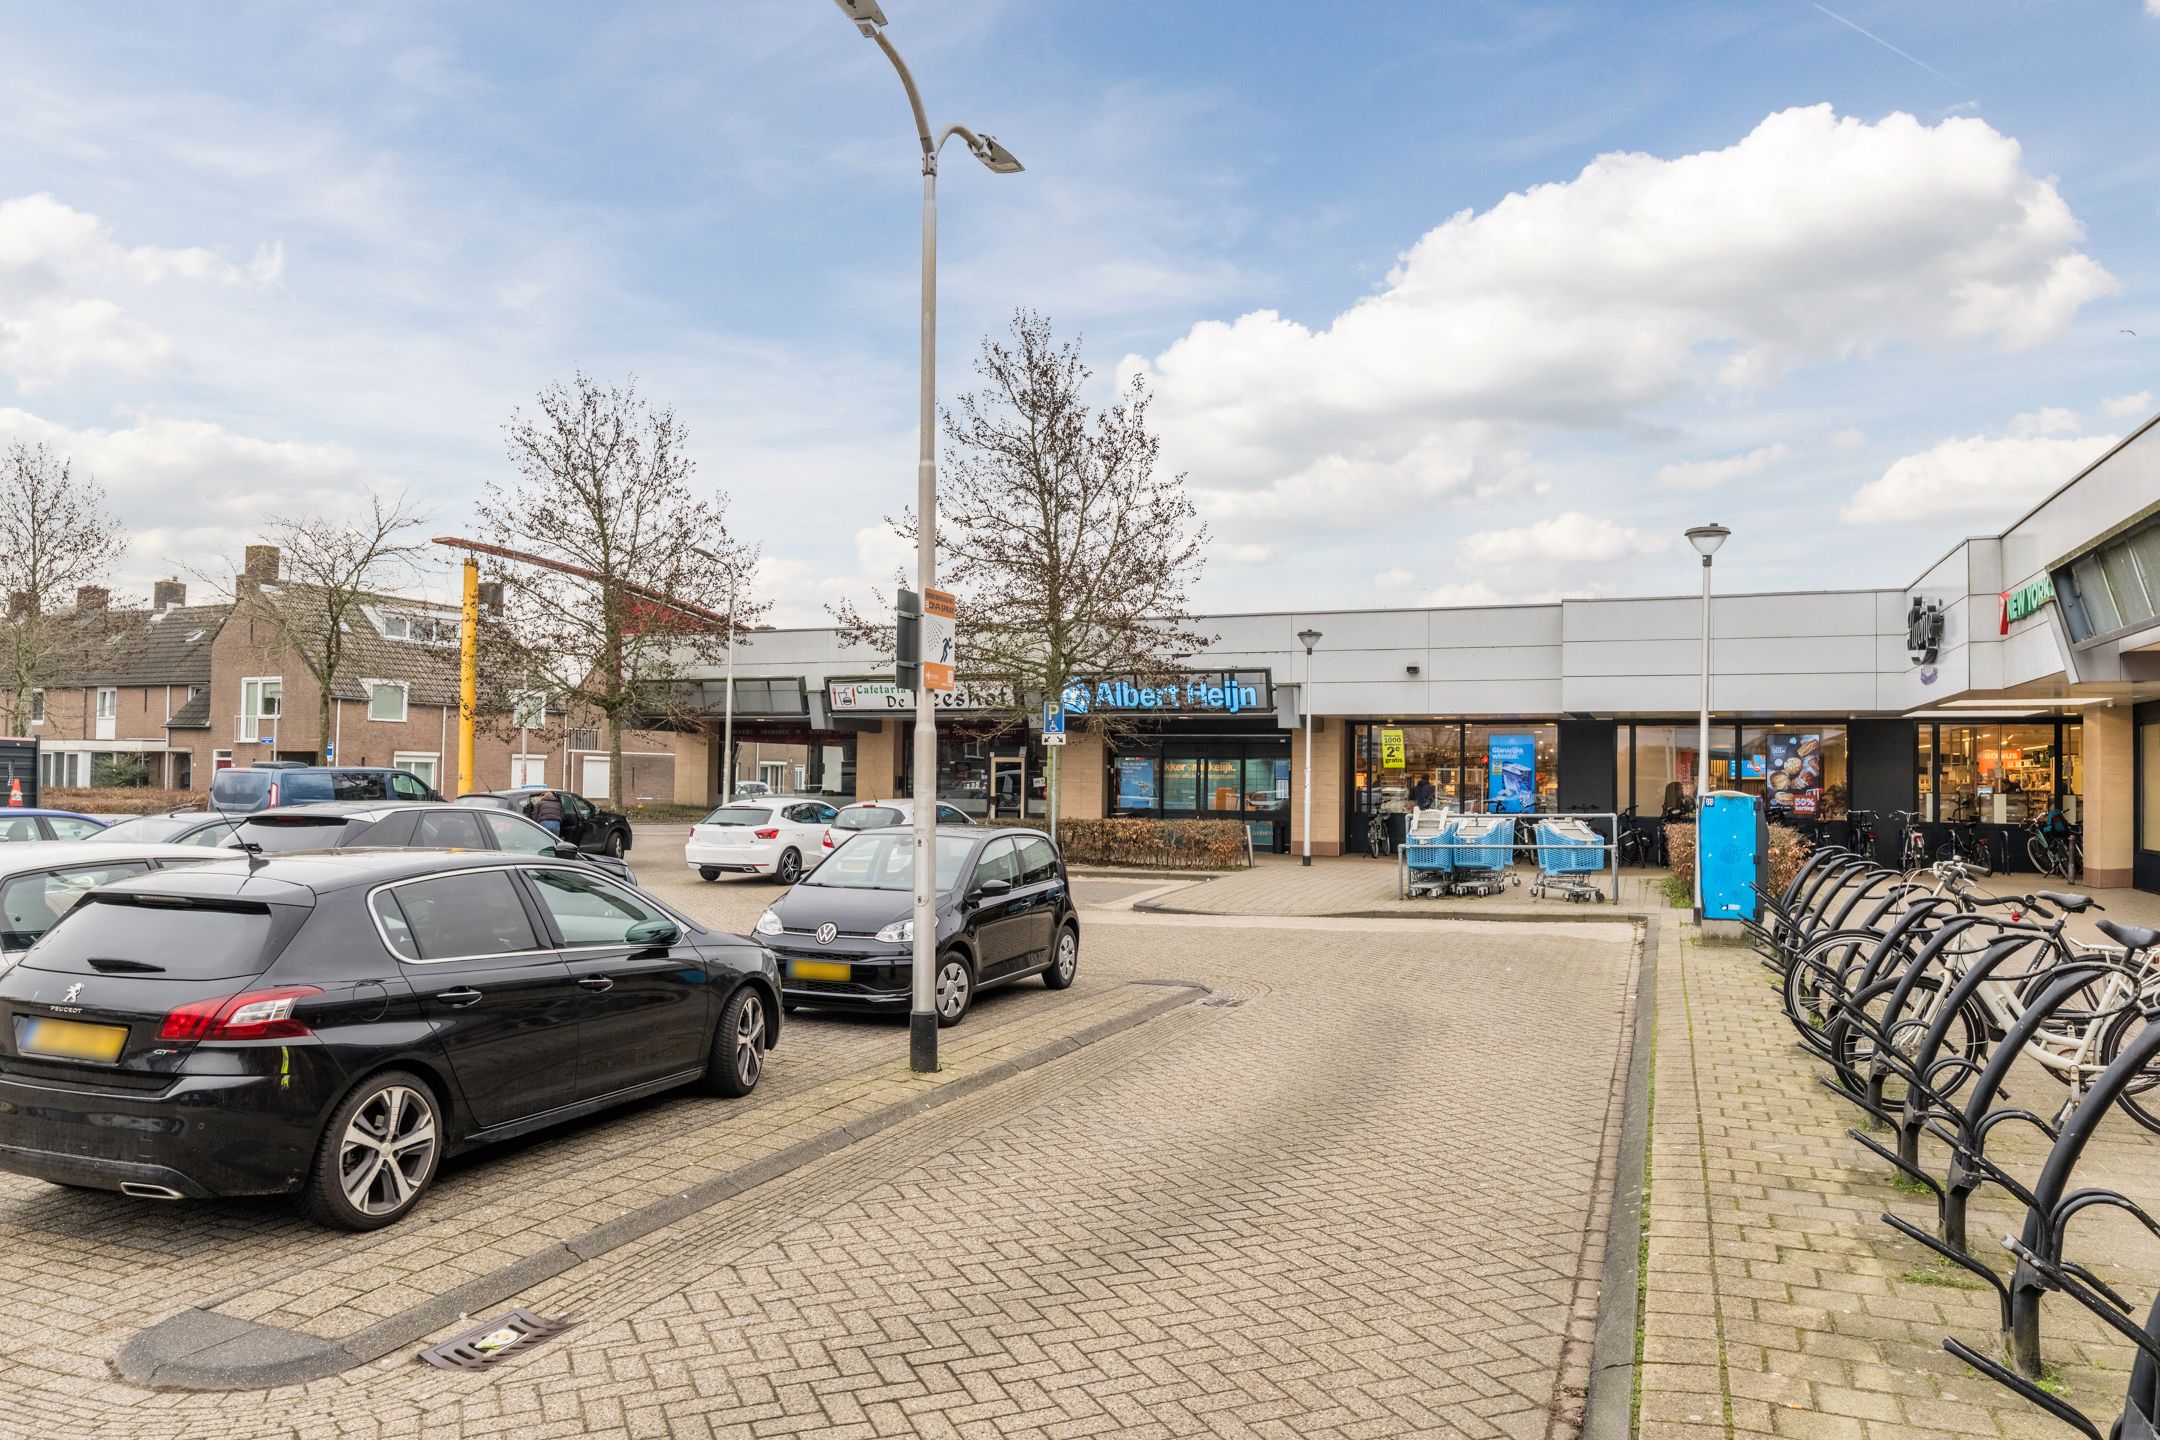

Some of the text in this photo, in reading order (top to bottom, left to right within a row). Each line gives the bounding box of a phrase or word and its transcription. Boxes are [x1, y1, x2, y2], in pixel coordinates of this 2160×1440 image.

[2007, 576, 2050, 620] NEW YORK
[886, 695, 905, 708] De
[1095, 680, 1257, 713] Albert Heijn
[1048, 704, 1060, 721] P
[1794, 797, 1815, 806] 50%
[50, 1005, 82, 1014] PEUGEOT
